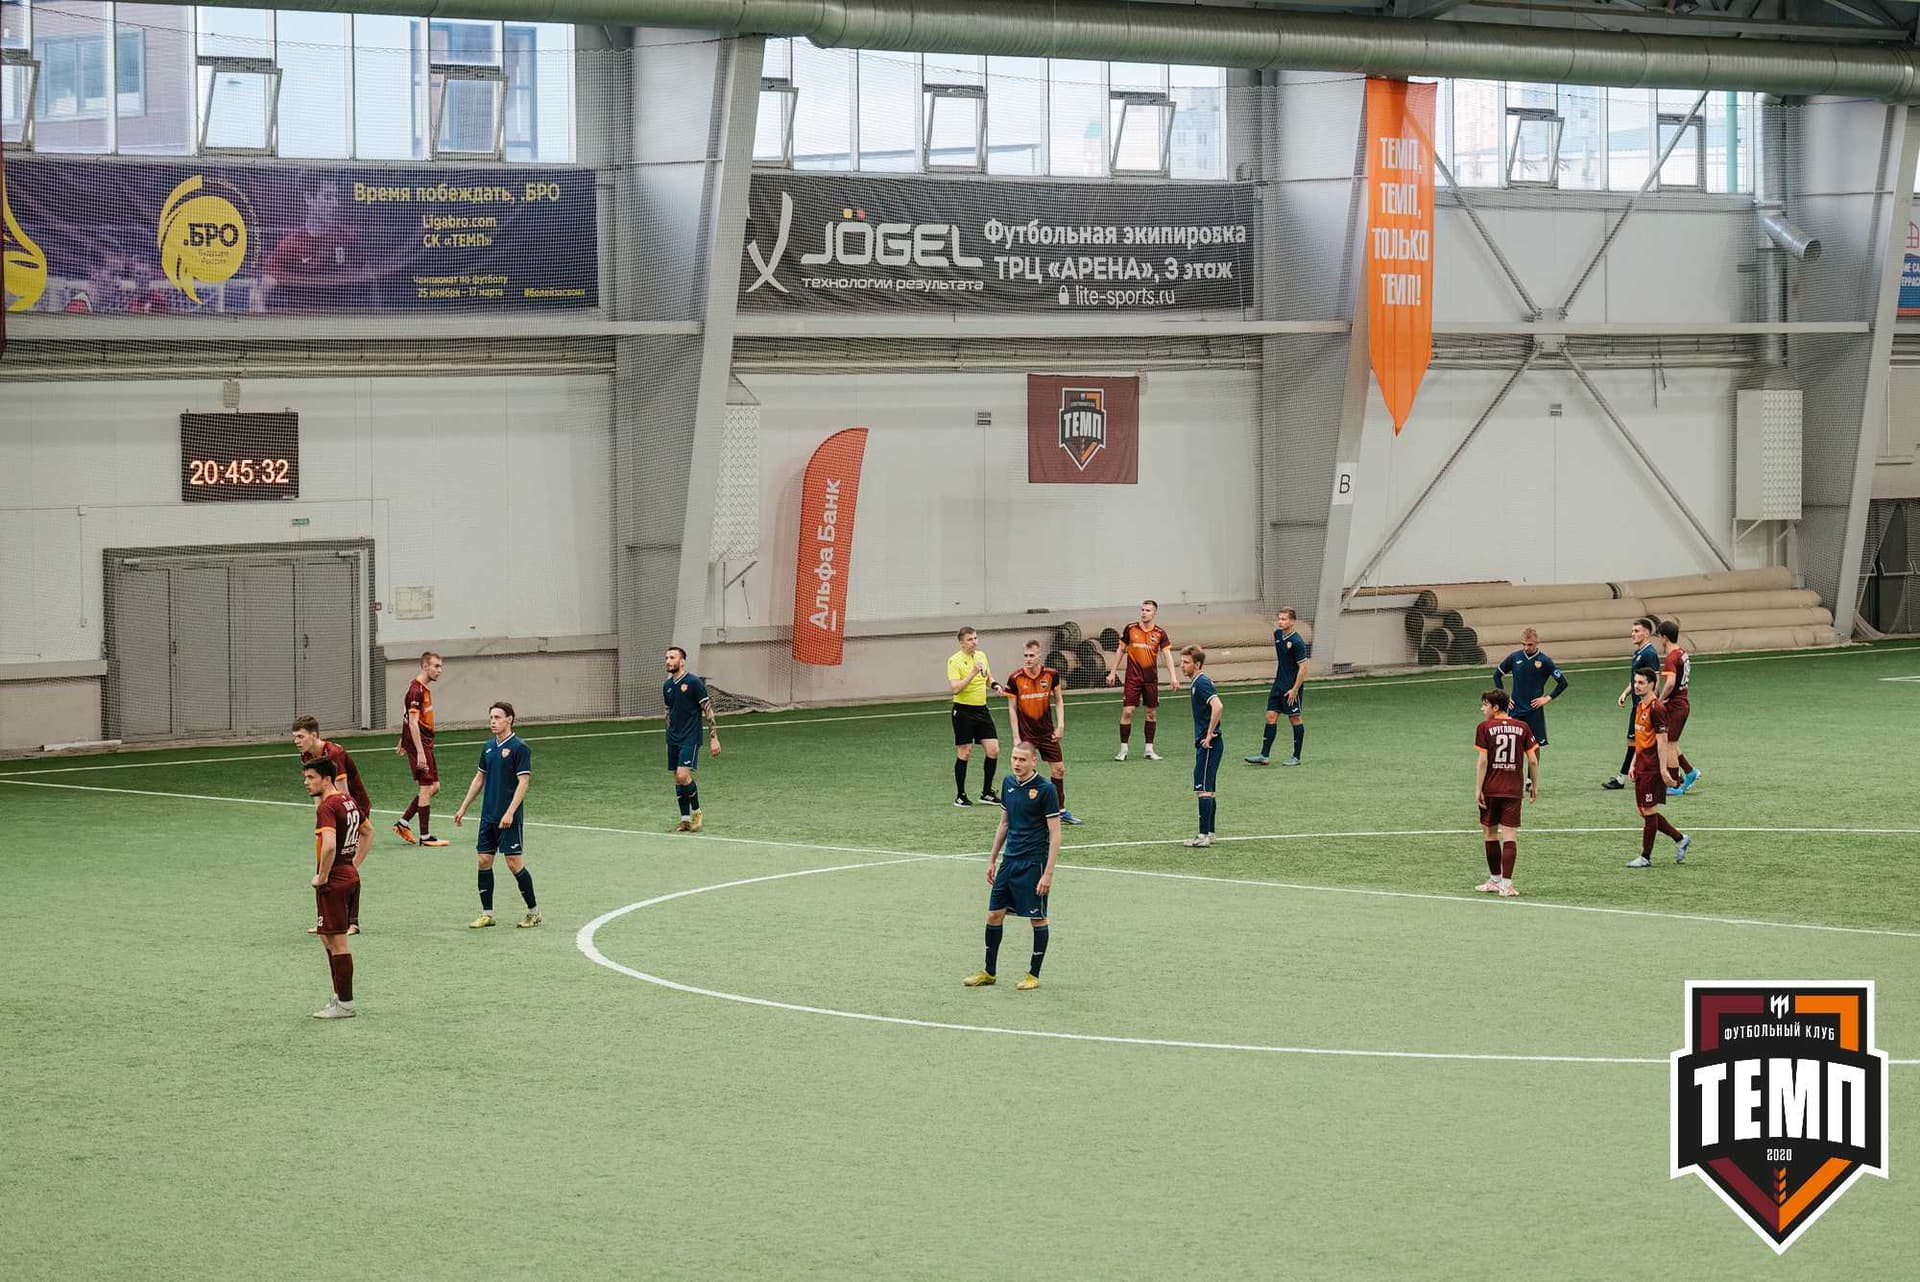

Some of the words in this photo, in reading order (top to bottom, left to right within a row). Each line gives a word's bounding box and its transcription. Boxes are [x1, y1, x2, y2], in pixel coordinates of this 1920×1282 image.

[1380, 138, 1422, 174] ТЕМП,
[354, 183, 410, 205] Время
[416, 184, 515, 205] побеждать,
[521, 183, 560, 201] .БРО
[1380, 183, 1422, 219] ТЕМП,
[184, 223, 239, 247] .БРО
[423, 215, 497, 230] Ligabro.com
[984, 219, 1117, 249] Футбольная
[1123, 225, 1246, 249] экипировка
[423, 234, 440, 247] СК
[444, 234, 493, 247] «ТЕМП»
[1372, 228, 1429, 261] ТОЛЬКО
[472, 274, 508, 285] футболу
[994, 256, 1043, 283] ТРЦ
[1048, 256, 1160, 283] «АРЕНА»,
[1165, 257, 1179, 280] 3
[1183, 260, 1233, 280] этаж
[430, 288, 460, 298] ноября
[479, 288, 504, 298] марта
[801, 277, 893, 289] технологии
[896, 279, 984, 292] результата
[1076, 285, 1176, 308] lite-sports.ru
[1381, 273, 1422, 306] ТЕМП!
[1063, 411, 1102, 439] ТЕМП
[190, 459, 289, 484] 20:45:32
[816, 478, 841, 542] Банк
[809, 546, 837, 632] Альфа
[1495, 734, 1517, 763] 21
[344, 810, 360, 847] 22
